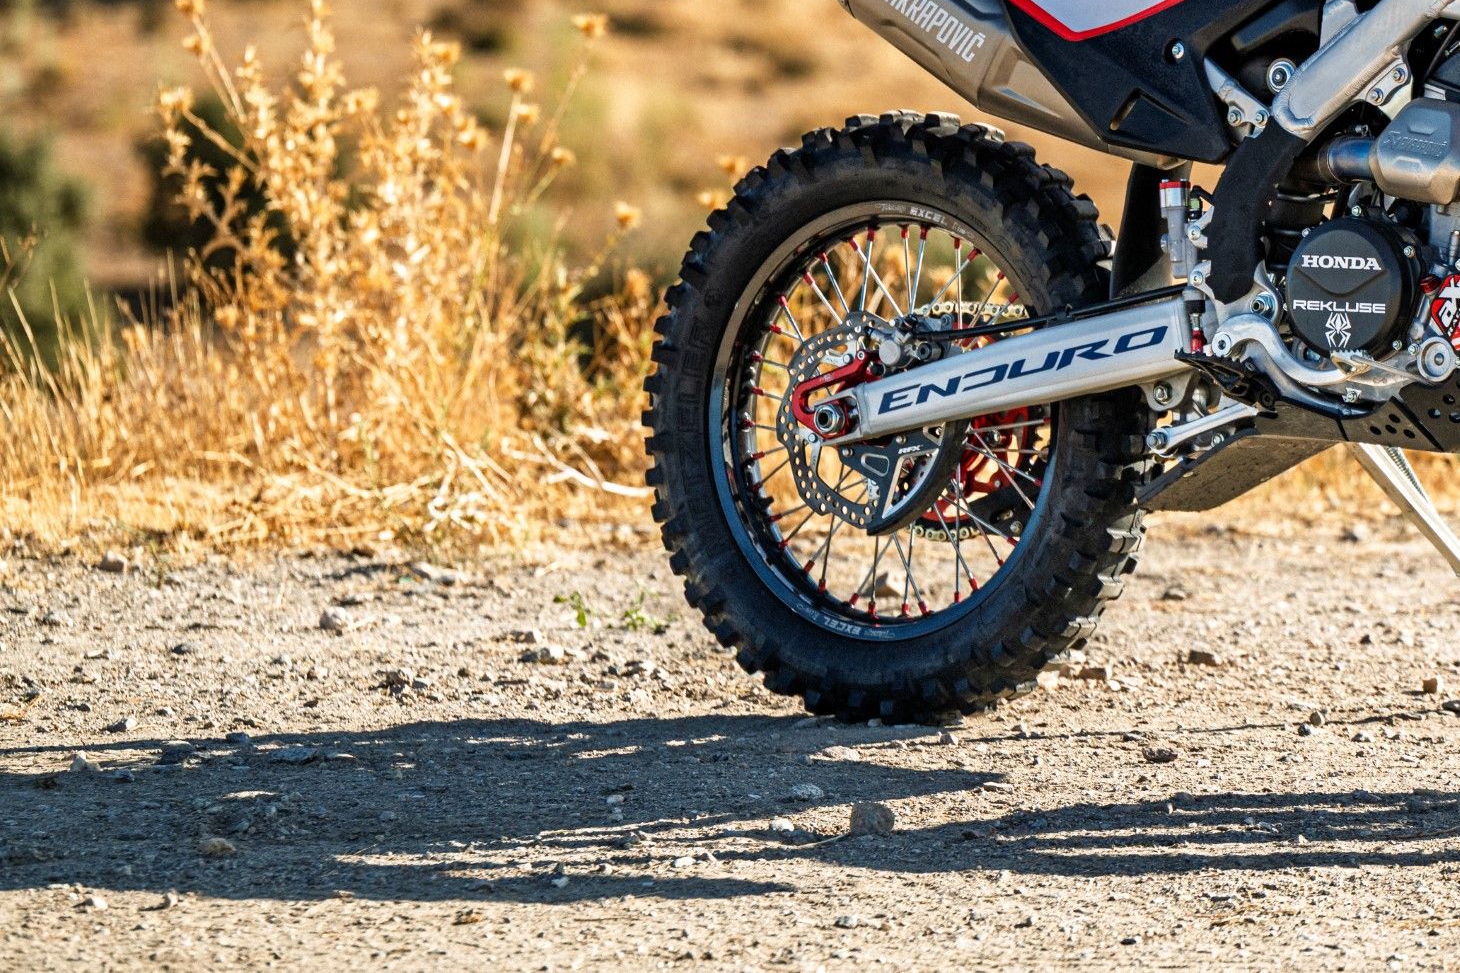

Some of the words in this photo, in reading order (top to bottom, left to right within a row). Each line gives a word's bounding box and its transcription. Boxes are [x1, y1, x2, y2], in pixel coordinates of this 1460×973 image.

[909, 206, 948, 226] EXCEL
[1301, 254, 1382, 271] HONDA
[1292, 299, 1387, 314] REKLUSE
[877, 325, 1169, 415] ENDURO
